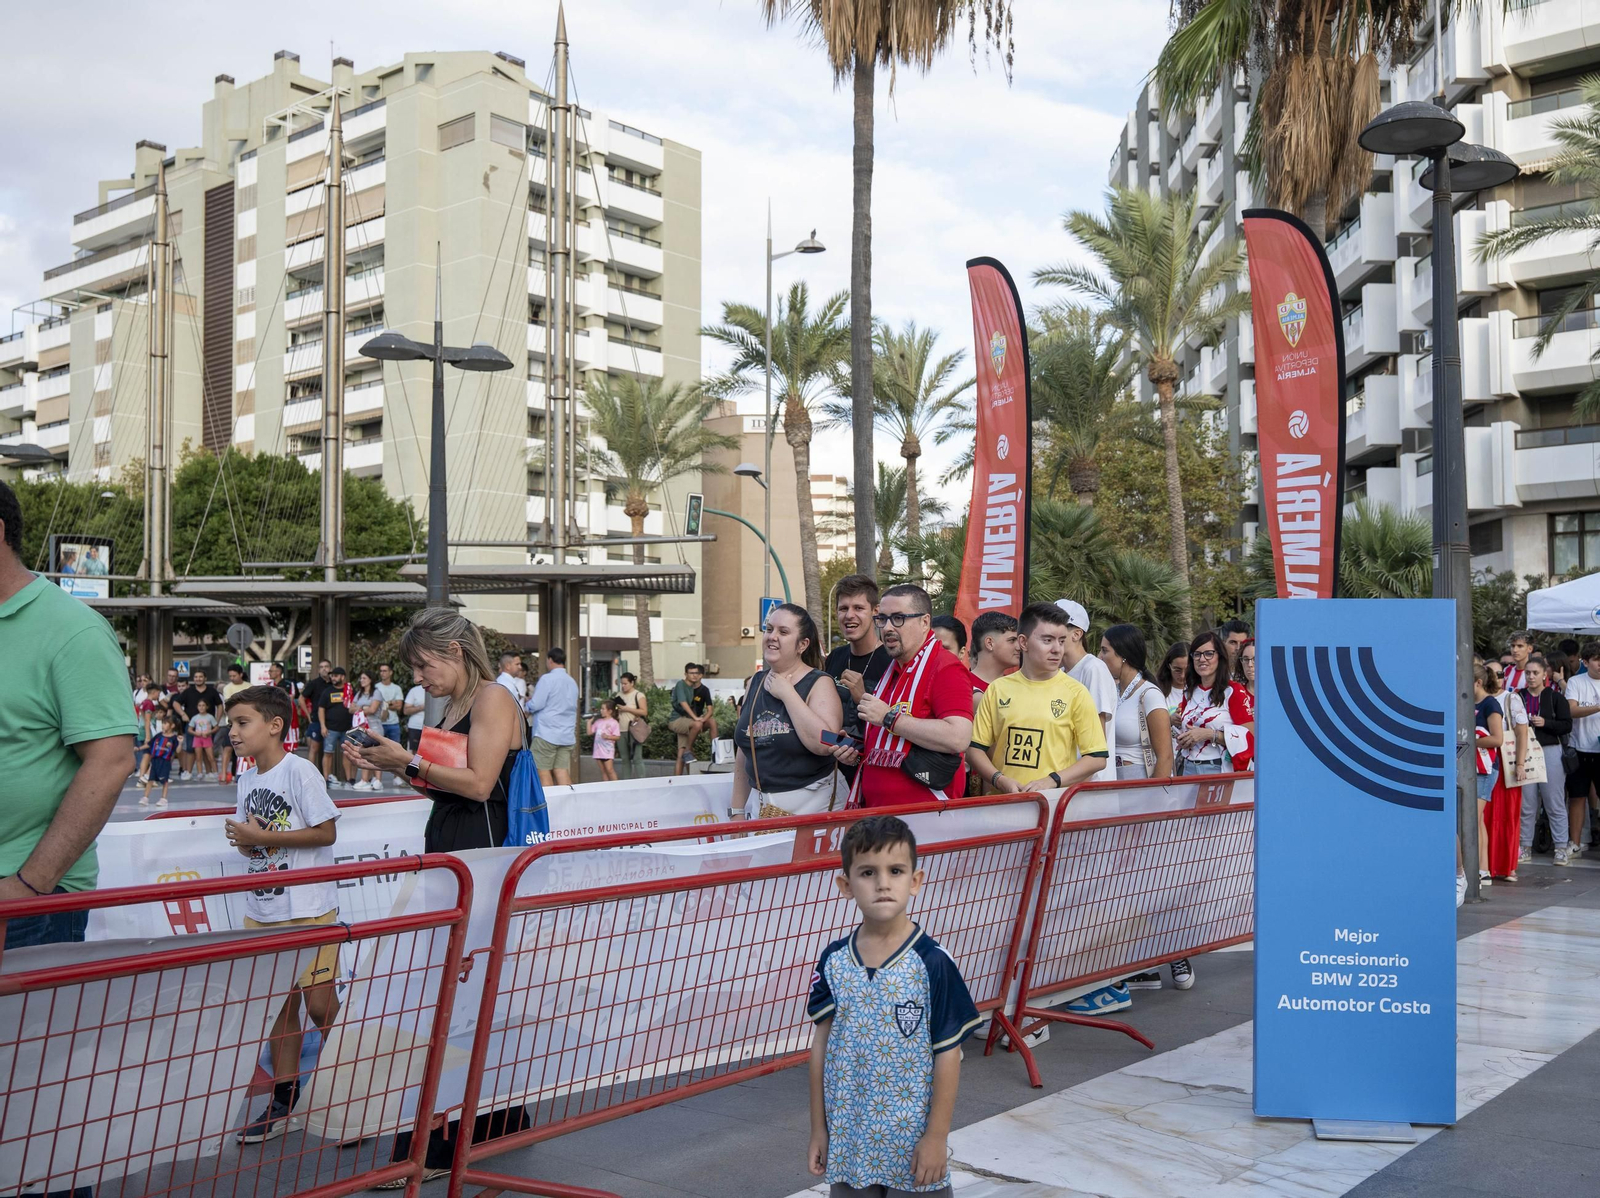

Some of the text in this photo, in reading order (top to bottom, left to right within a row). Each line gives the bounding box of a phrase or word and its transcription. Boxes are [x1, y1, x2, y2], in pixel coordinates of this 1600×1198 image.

[1139, 711, 1147, 732] GUESS
[1014, 733, 1033, 747] DA
[1011, 747, 1032, 762] ZN
[597, 822, 645, 834] MUNICIPAL
[647, 820, 659, 829] DE
[1334, 928, 1380, 945] Mejor
[1299, 951, 1410, 968] Concesionario
[1311, 972, 1399, 988] BMW 2023
[1277, 994, 1431, 1015] Automotor Costa
